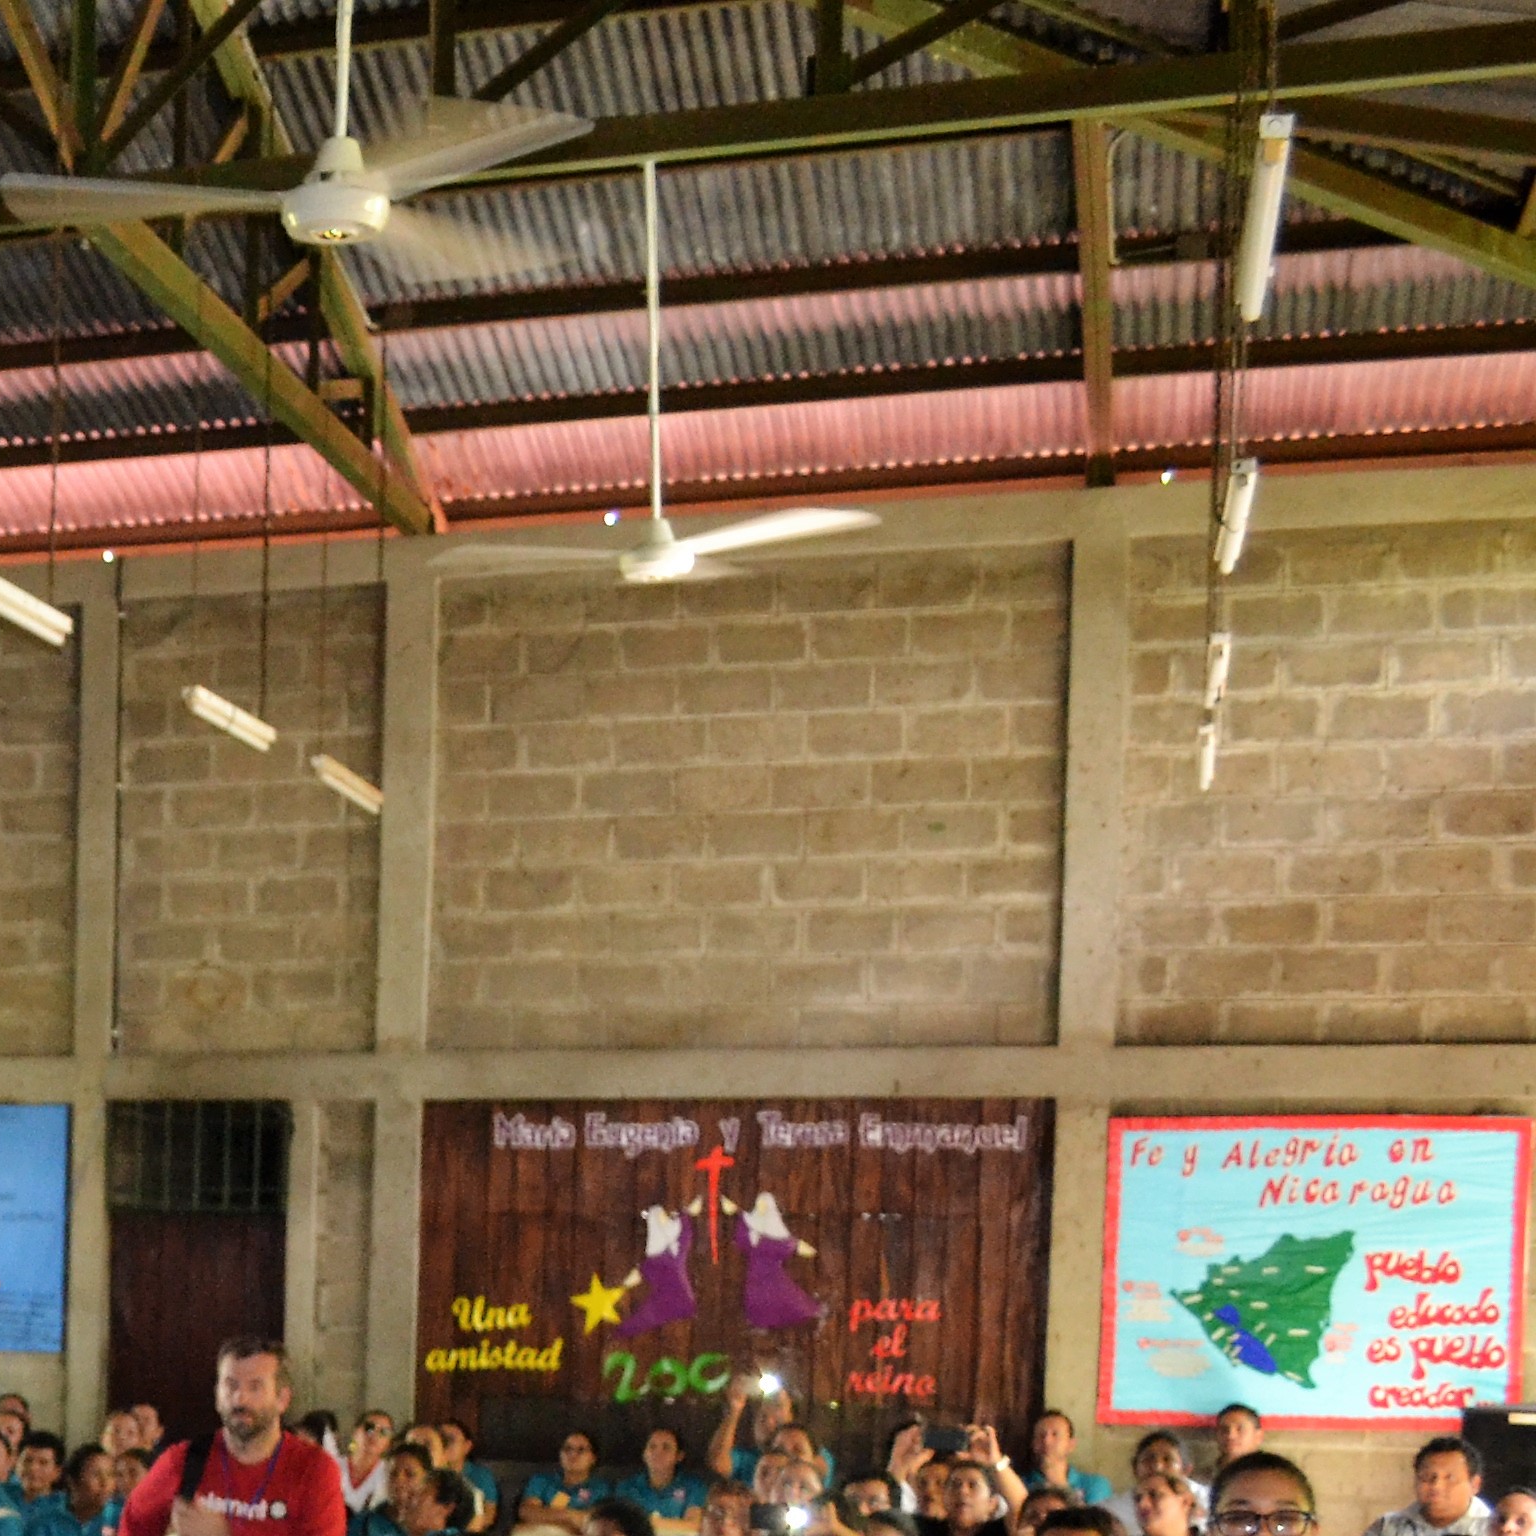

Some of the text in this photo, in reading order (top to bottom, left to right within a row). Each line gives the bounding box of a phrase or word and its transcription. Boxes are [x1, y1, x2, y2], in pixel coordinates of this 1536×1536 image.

[718, 1117, 741, 1154] y
[1130, 1137, 1164, 1168] Fe
[1181, 1144, 1199, 1177] y
[1388, 1137, 1434, 1164] en
[1259, 1174, 1458, 1210] Nicaragua
[451, 1295, 532, 1332] Una
[849, 1298, 942, 1333] para
[1388, 1287, 1501, 1330] educado
[425, 1337, 563, 1372] amistad
[872, 1323, 908, 1358] el
[1366, 1335, 1402, 1364] es
[849, 1365, 936, 1397] reino
